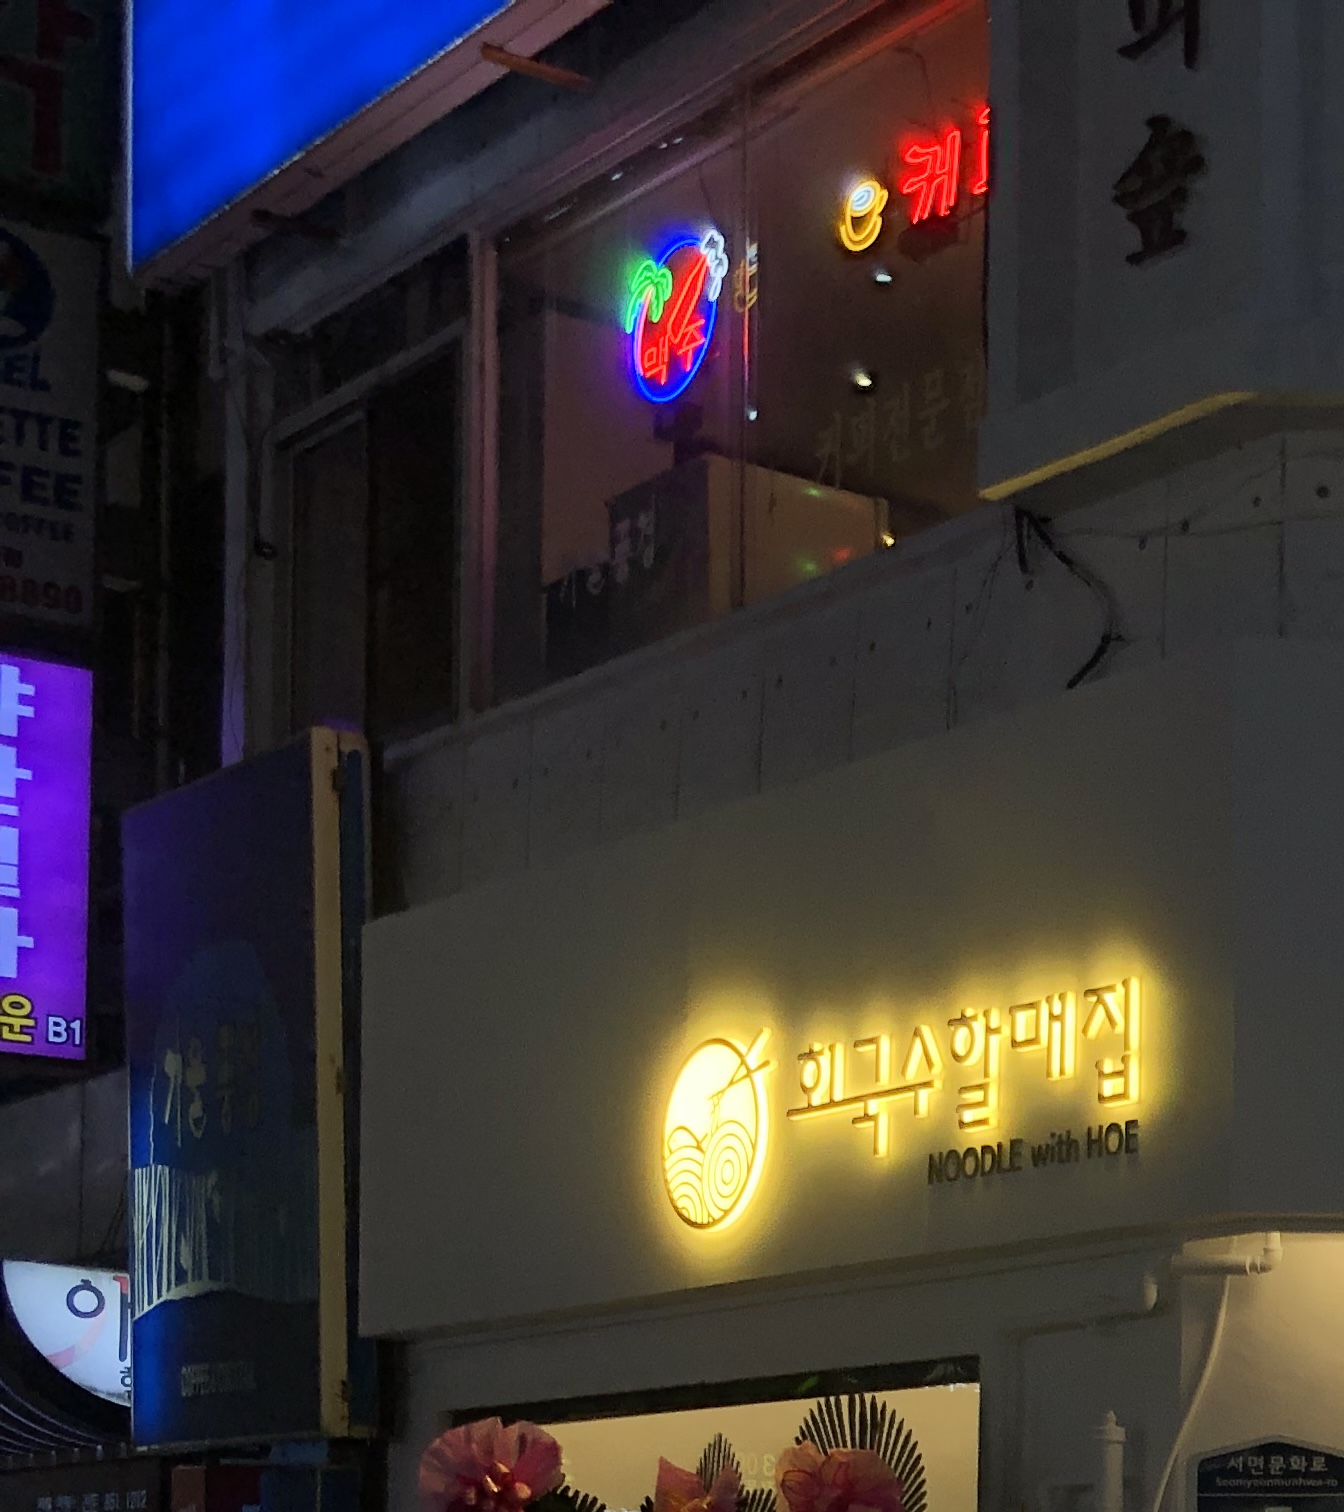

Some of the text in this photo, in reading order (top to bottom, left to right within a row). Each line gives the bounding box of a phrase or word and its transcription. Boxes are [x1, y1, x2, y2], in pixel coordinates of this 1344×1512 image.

[903, 105, 990, 225] 커
[642, 316, 706, 386] 맥주
[46, 1014, 83, 1046] B1
[786, 976, 1140, 1157] 회국수할매집
[926, 1119, 1139, 1185] NOODLE with HOE
[1226, 1454, 1328, 1475] 서면문화로
